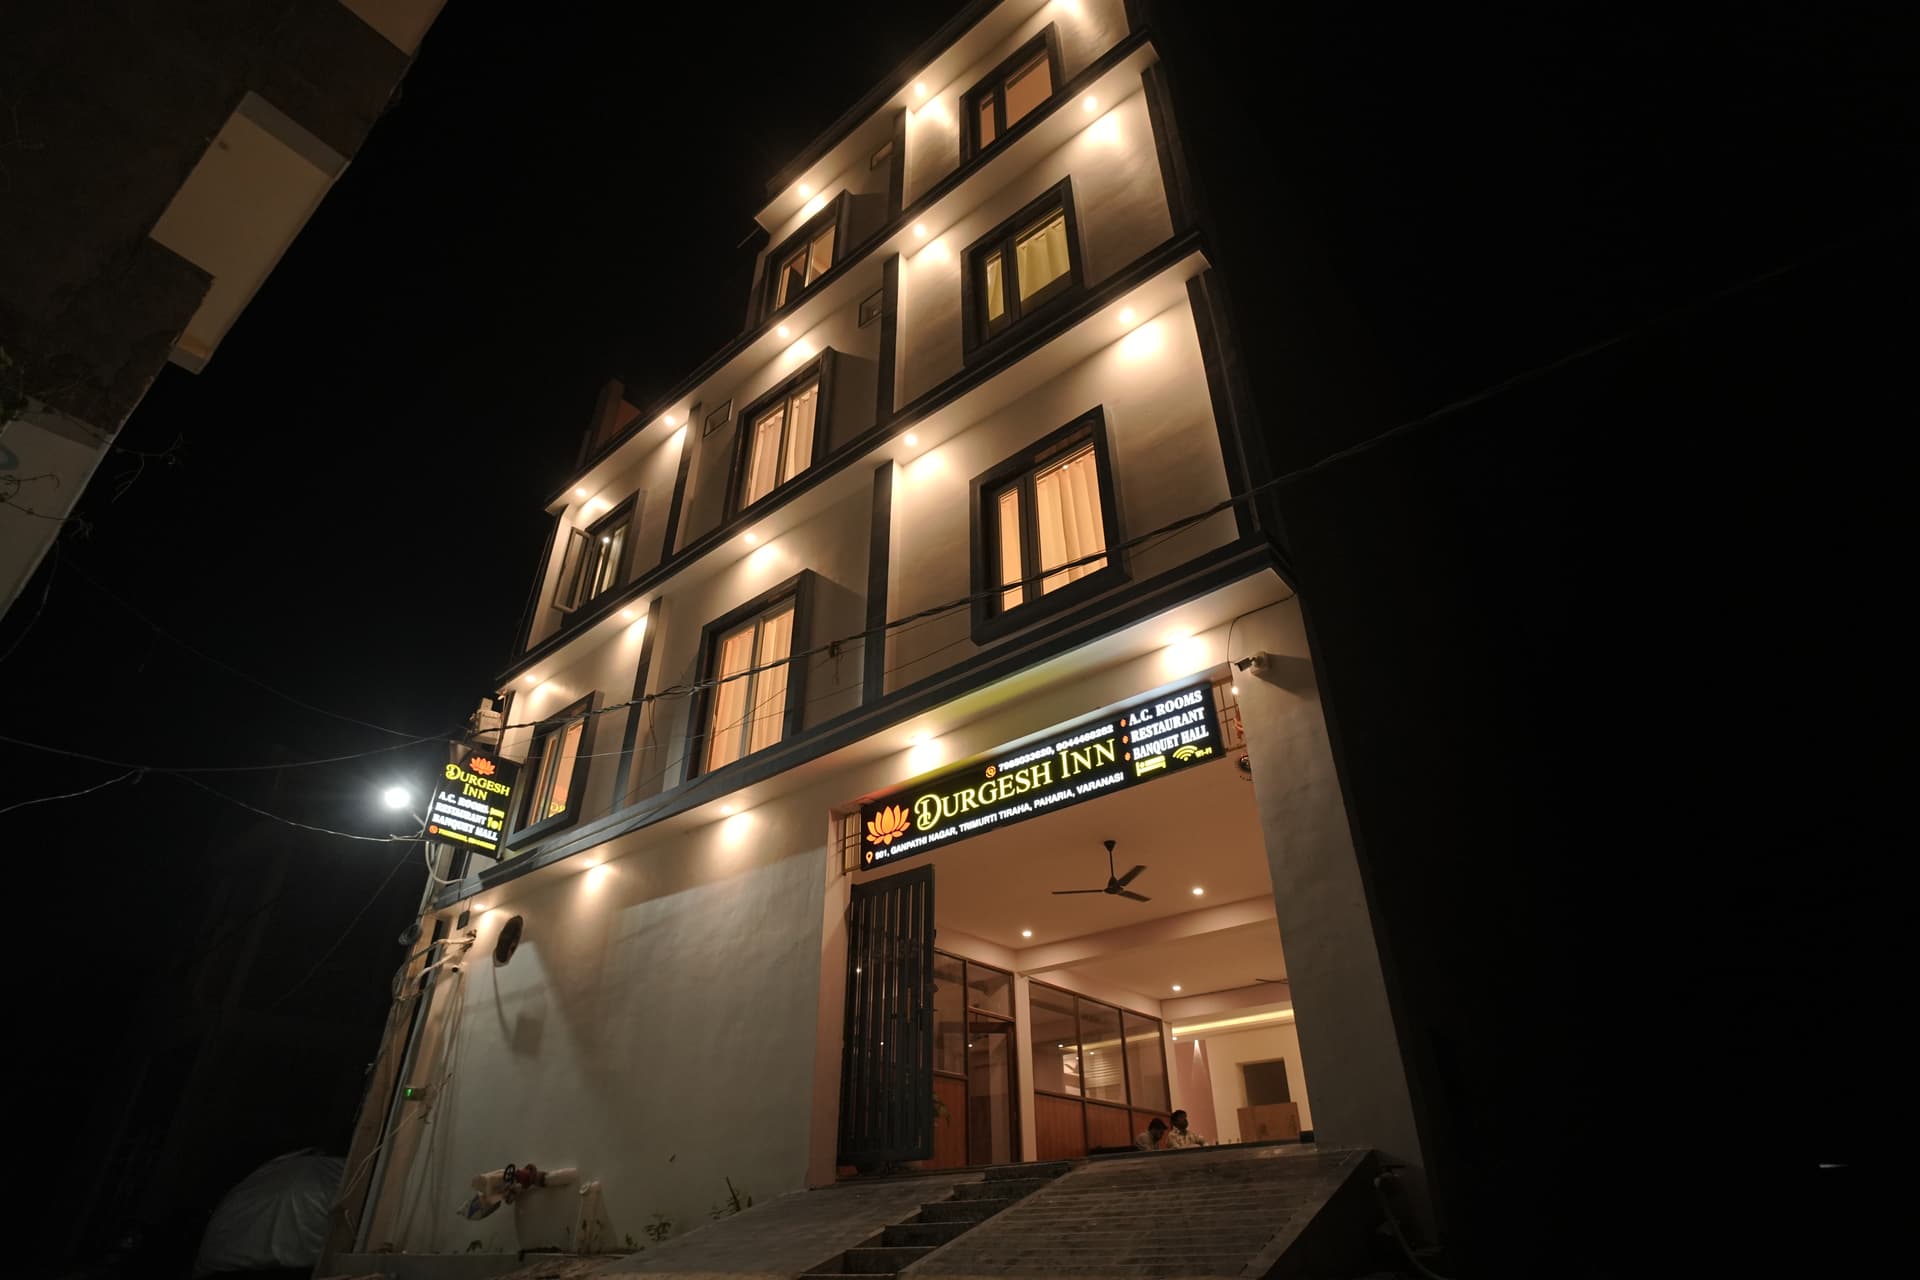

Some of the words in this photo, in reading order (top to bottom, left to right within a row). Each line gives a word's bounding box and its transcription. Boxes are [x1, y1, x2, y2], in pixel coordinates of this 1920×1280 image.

[1128, 709, 1153, 726] A.C.
[1155, 690, 1203, 717] ROOMS
[1130, 706, 1205, 743] RESTAURANT
[1132, 733, 1180, 760] BANQUET
[1180, 724, 1209, 745] HALL
[438, 791, 457, 804] A.C.
[445, 763, 511, 797] DURGESH
[463, 783, 488, 801] INN
[914, 759, 1054, 831] DURGESH
[1059, 738, 1116, 779] INN
[928, 826, 958, 843] NAGAR,
[959, 813, 998, 833] TRIMURTI
[999, 803, 1033, 820] TIRAHA,
[1034, 789, 1076, 809] PAHARIA,
[1076, 771, 1125, 795] VARANASI
[431, 813, 475, 834] BANQUET
[474, 826, 498, 841] HALL
